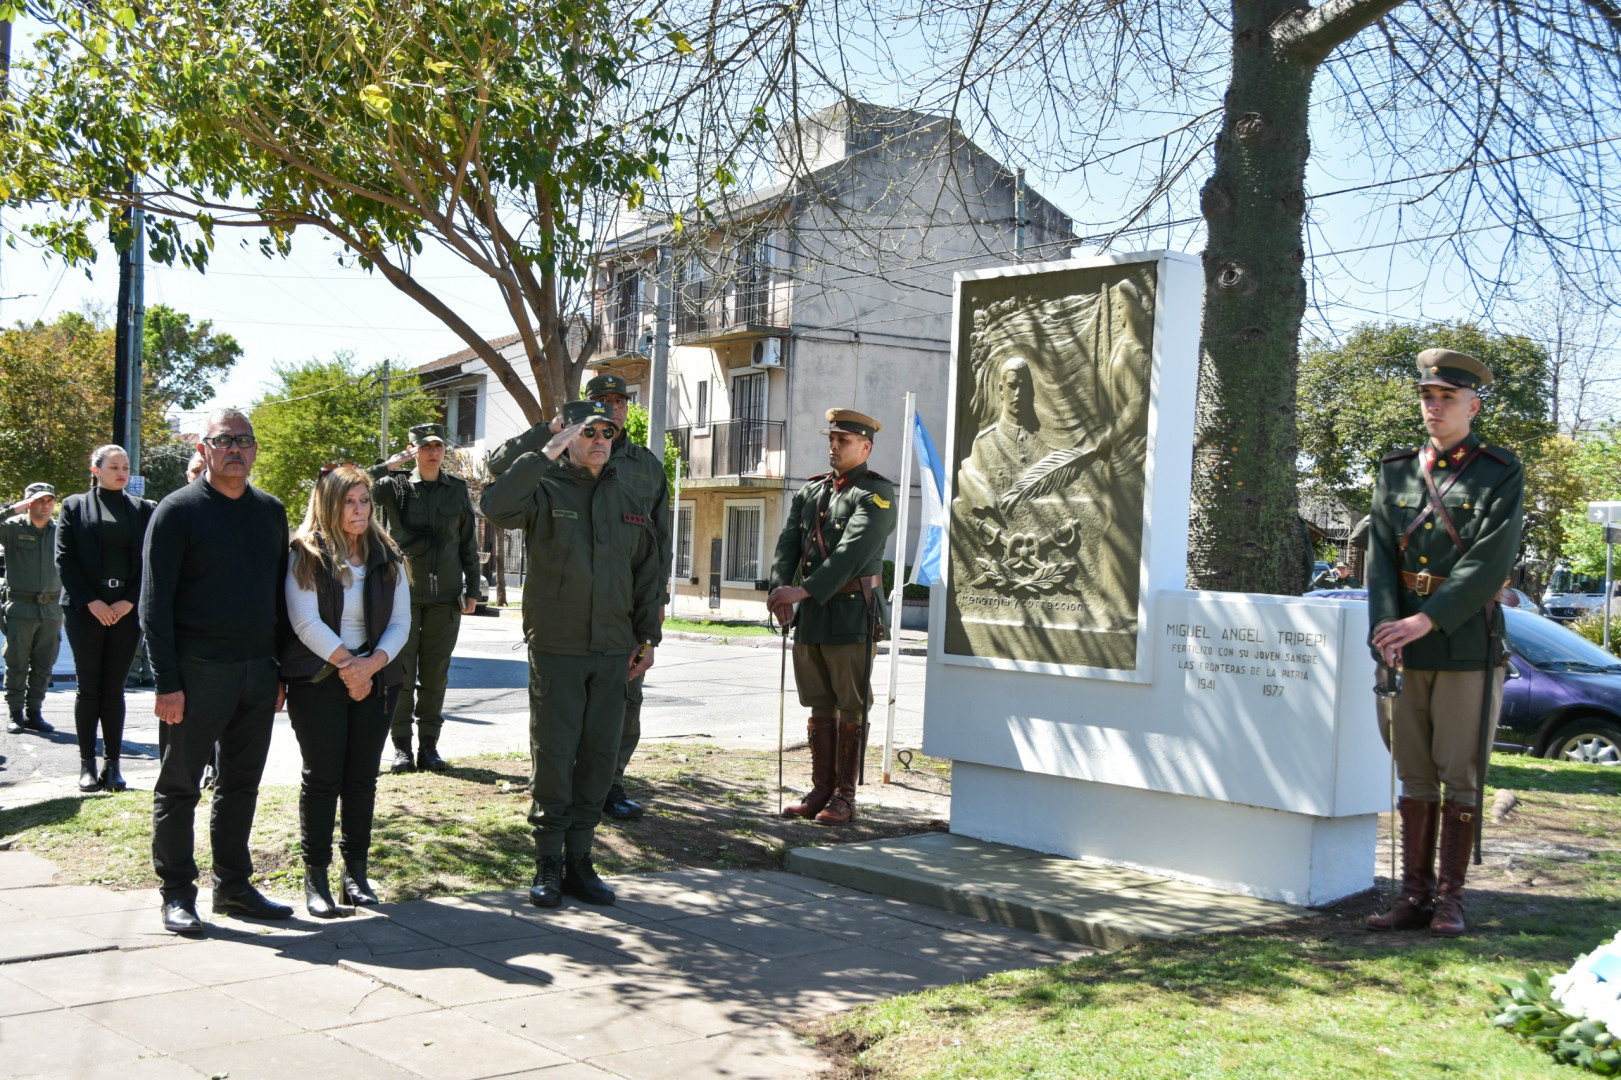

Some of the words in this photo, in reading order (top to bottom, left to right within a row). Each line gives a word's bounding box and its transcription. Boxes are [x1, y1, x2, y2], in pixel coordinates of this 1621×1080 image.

[1167, 624, 1210, 639] MIGUEL
[1221, 628, 1263, 643] ANGEL
[1277, 631, 1326, 648] TRIPEPI
[1172, 643, 1213, 655] FERTILIZO
[1218, 647, 1234, 657] CON
[1239, 649, 1249, 658] SU
[1253, 651, 1280, 661] JOVEN
[1285, 652, 1318, 665] SANGRE
[1178, 660, 1194, 670] LAS
[1199, 662, 1246, 675] FRONTERAS
[1250, 666, 1262, 676] DE
[1266, 668, 1277, 678] LA
[1282, 669, 1309, 681] PATRIA
[1198, 678, 1216, 691] 1941
[1262, 684, 1286, 697] 1977
